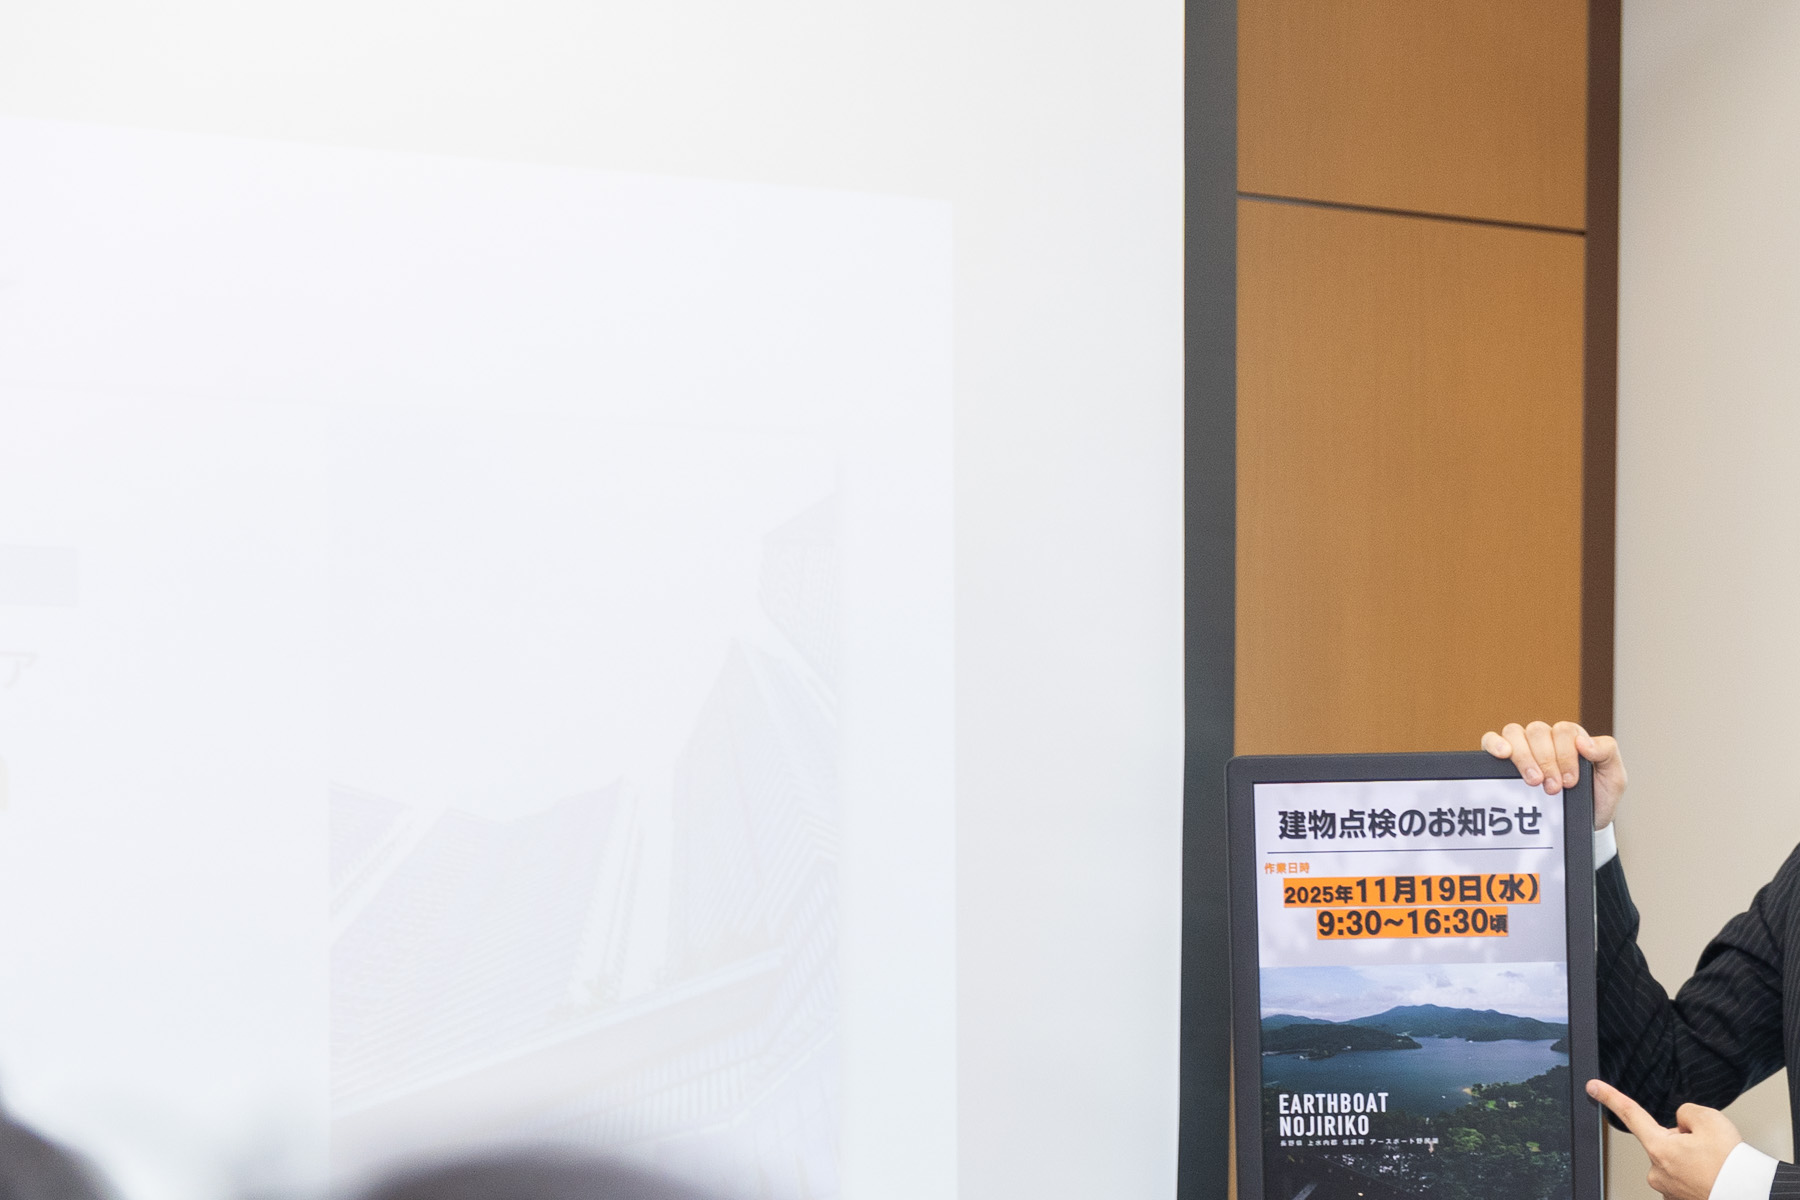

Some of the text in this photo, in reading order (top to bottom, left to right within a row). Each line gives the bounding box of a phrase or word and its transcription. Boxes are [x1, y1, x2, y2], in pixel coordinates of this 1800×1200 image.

[1278, 806, 1542, 840] 建物点検のお知らせ
[1264, 862, 1310, 875] 作業日時
[1284, 873, 1540, 904] 2025年11月19日(水)
[1279, 1092, 1389, 1115] EARTHBOAT
[1279, 1115, 1370, 1137] NOJIRIKO
